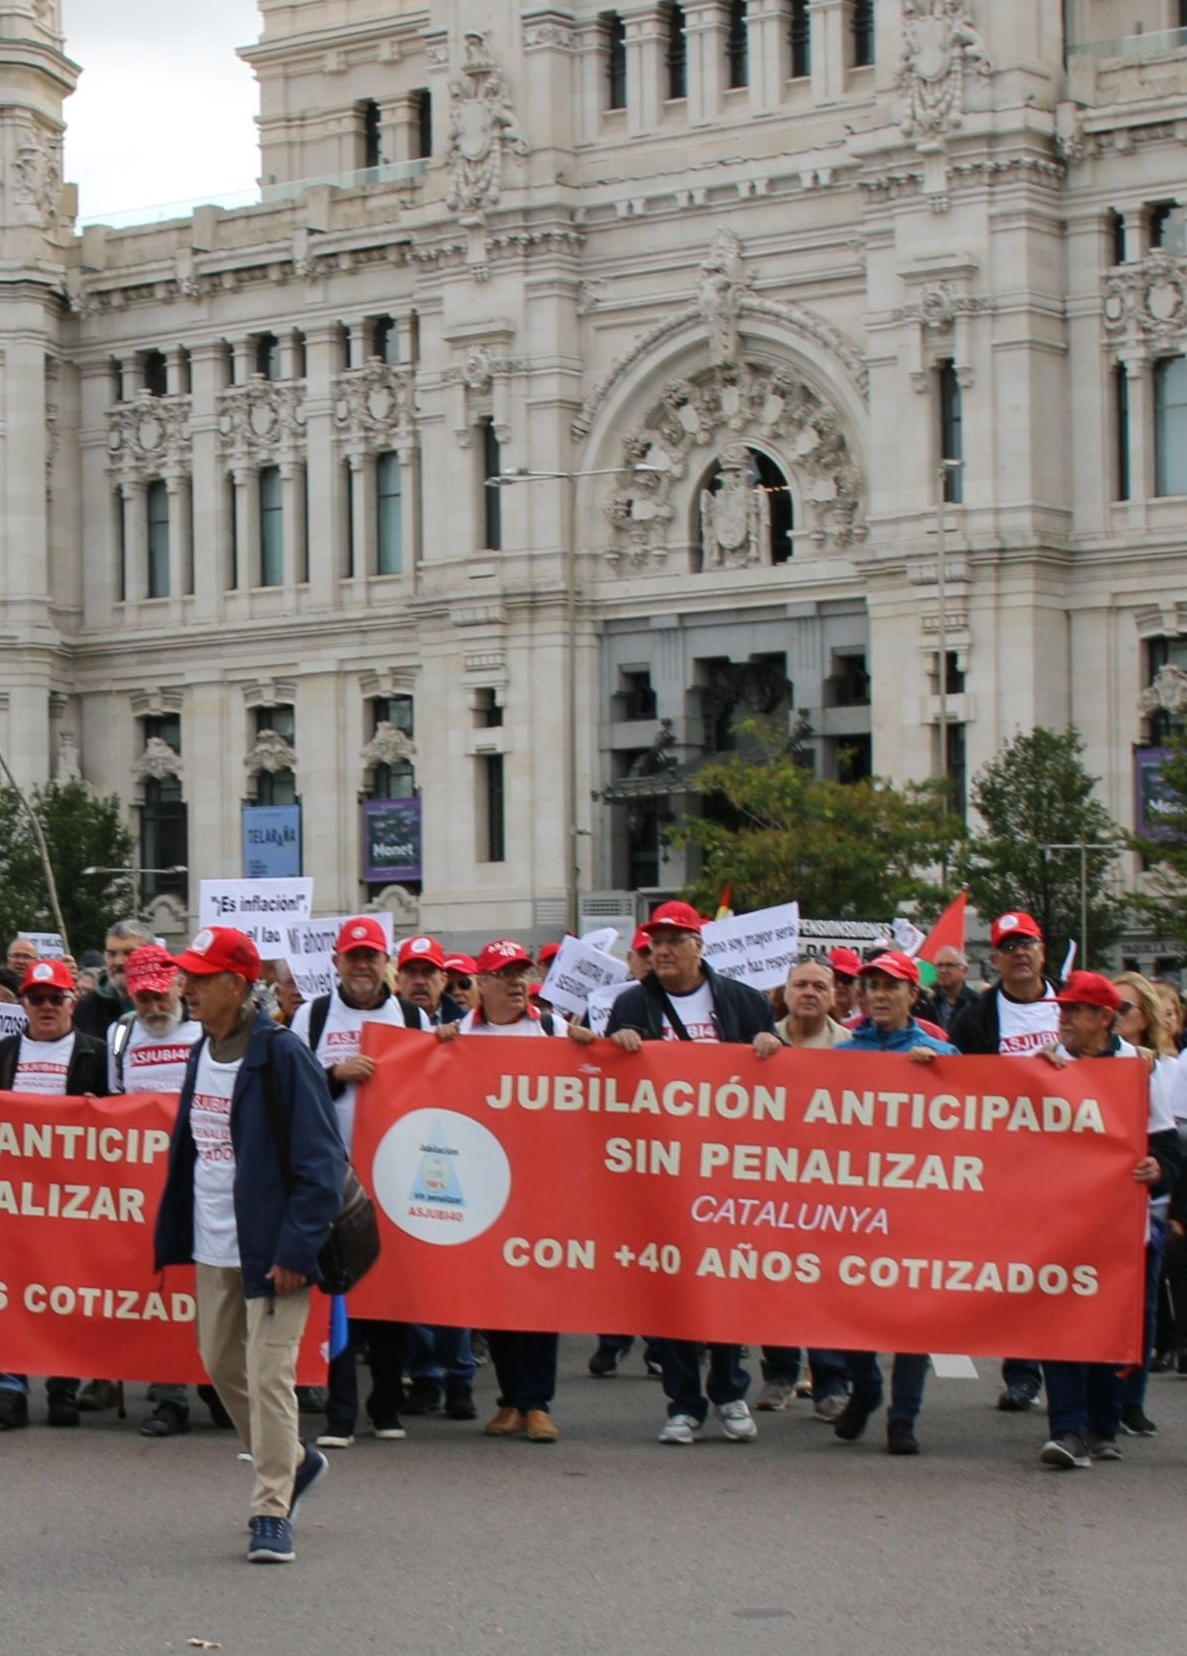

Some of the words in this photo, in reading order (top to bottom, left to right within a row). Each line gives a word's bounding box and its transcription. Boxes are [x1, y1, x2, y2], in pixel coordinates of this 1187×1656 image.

[373, 842, 414, 858] Monet
[485, 1073, 786, 1121] JUBILACIÓN
[804, 1088, 1107, 1134] ANTICIPADA
[604, 1136, 681, 1176] SIN
[700, 1143, 985, 1192] PENALIZAR
[408, 1206, 464, 1222] ASJUBI40
[691, 1195, 889, 1235] CATALUNYA
[503, 1236, 596, 1270] CON
[613, 1242, 681, 1275] +40
[696, 1241, 821, 1284] AÑOS
[839, 1254, 1099, 1297] COTIZADOS
[24, 1284, 196, 1323] COTIZAD
